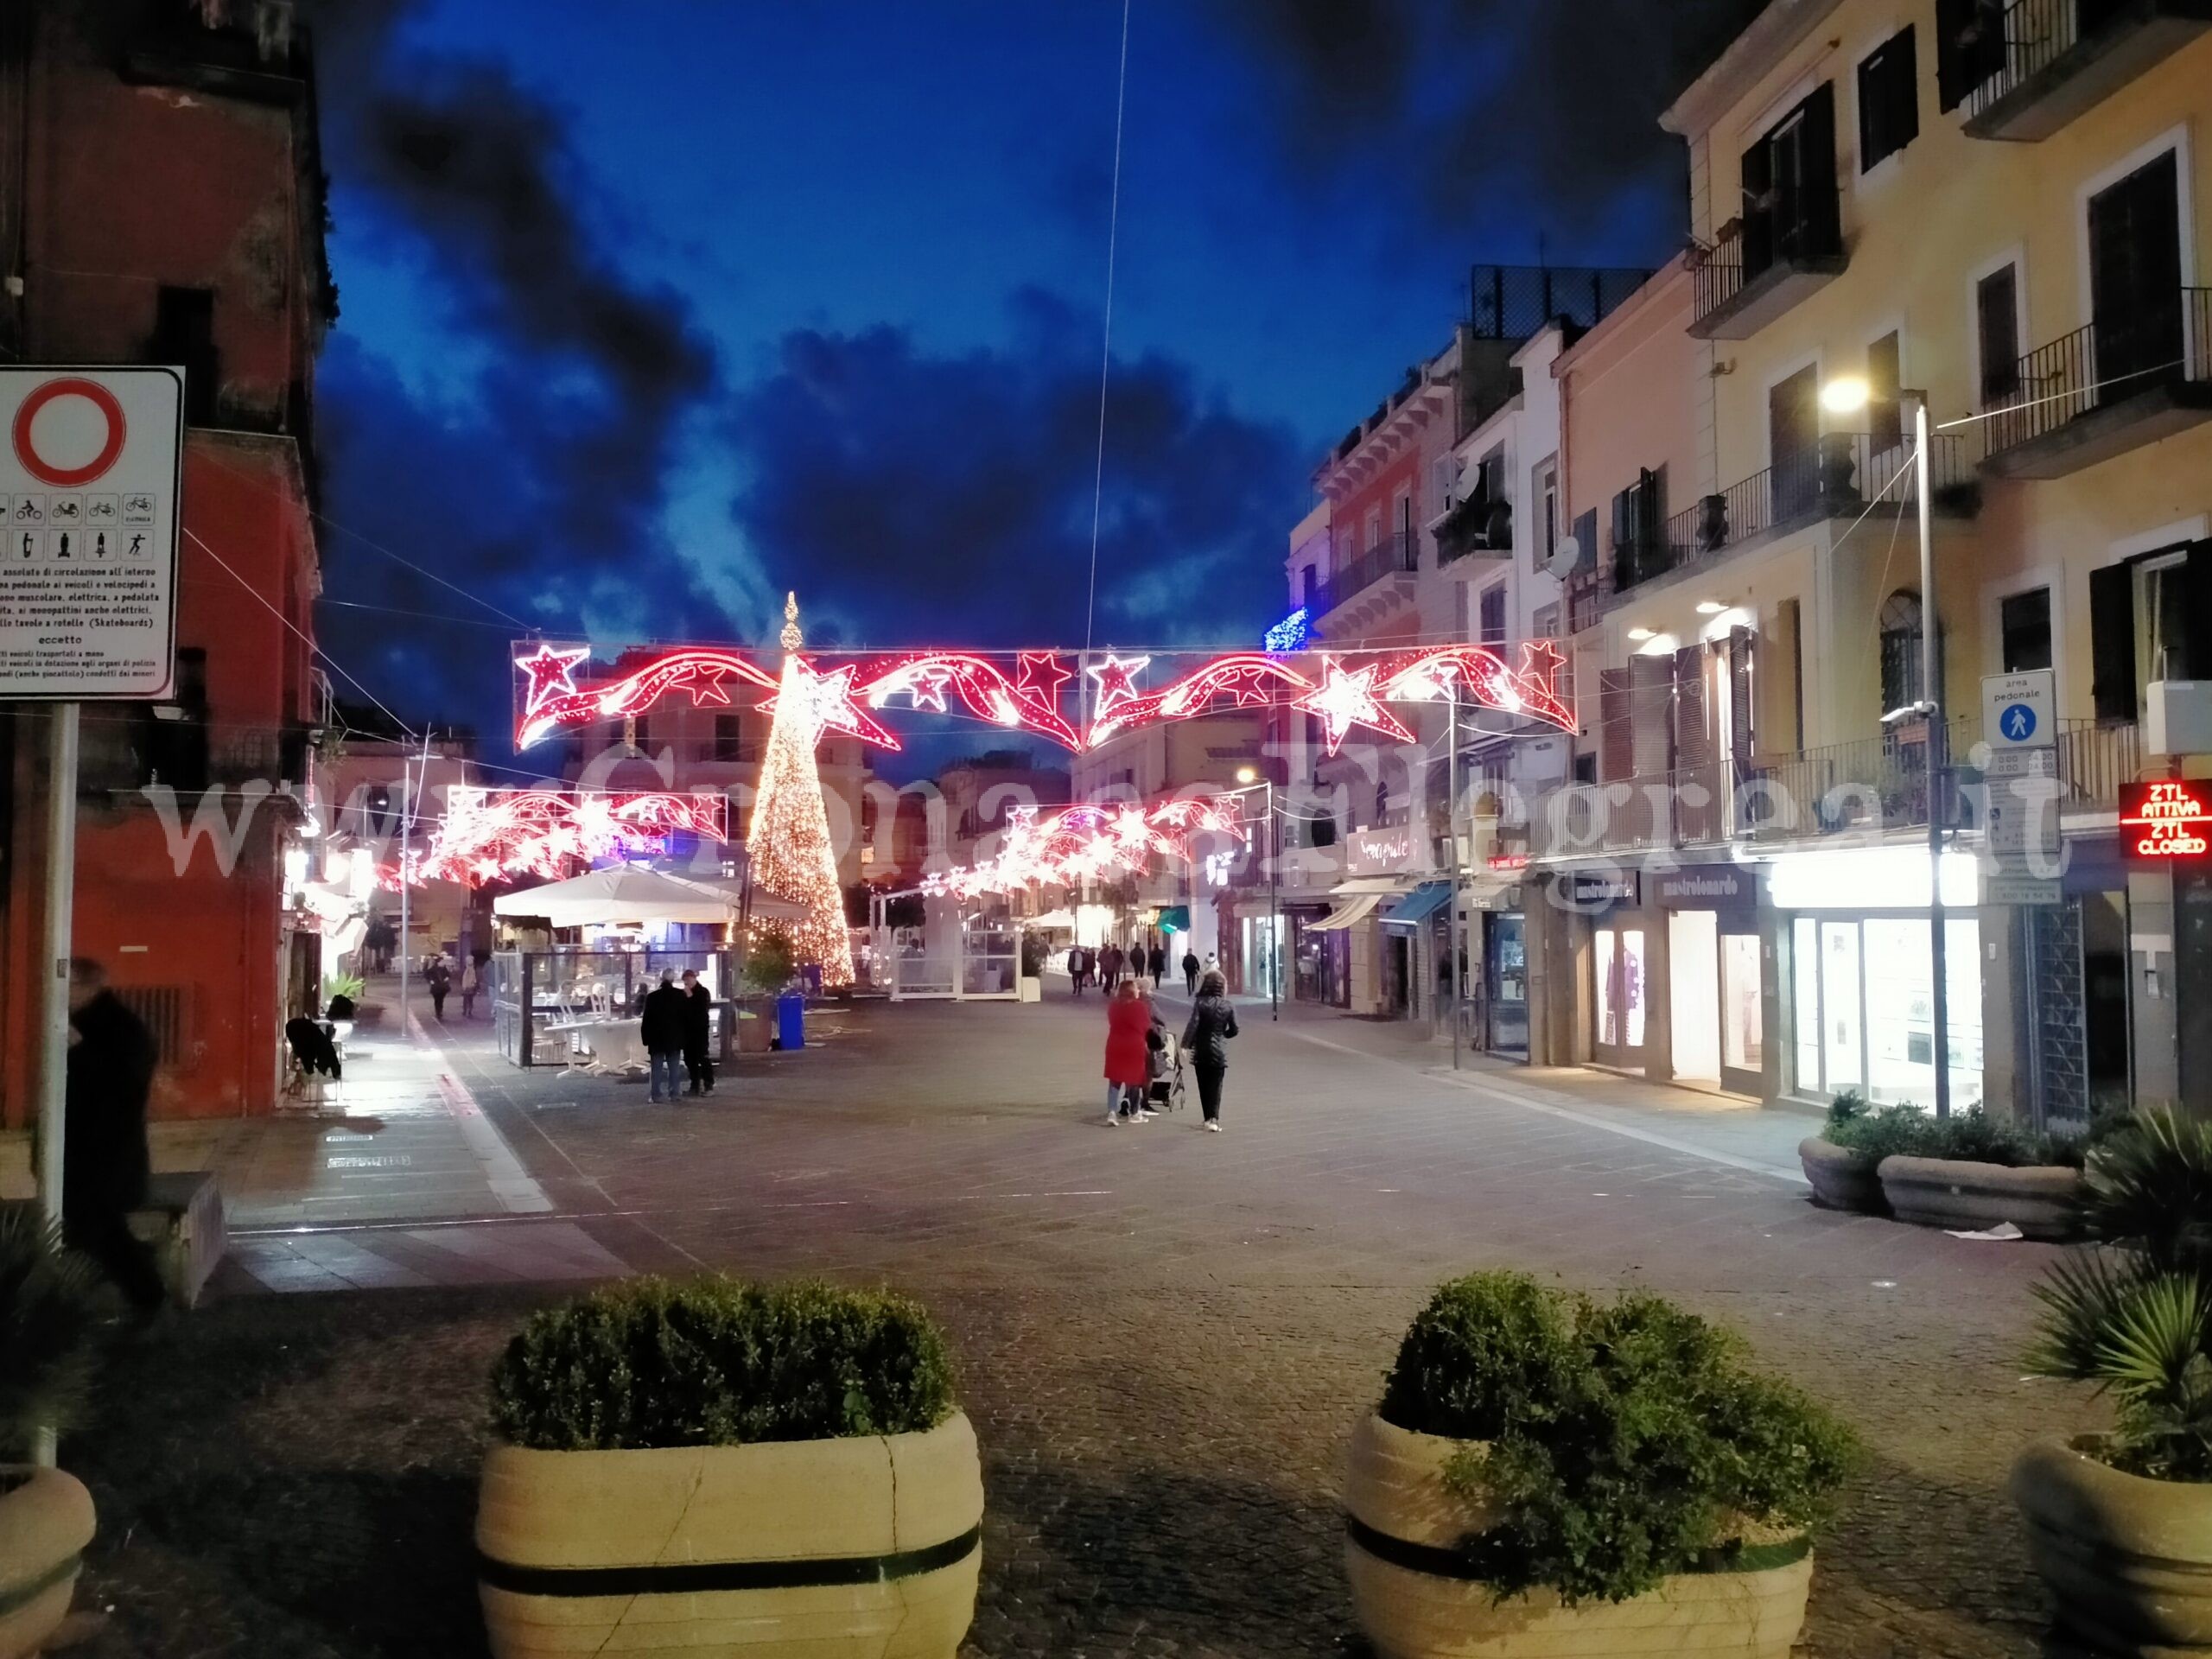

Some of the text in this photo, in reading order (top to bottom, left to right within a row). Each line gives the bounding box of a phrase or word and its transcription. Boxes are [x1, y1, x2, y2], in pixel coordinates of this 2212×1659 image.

[43, 567, 51, 576] di
[54, 567, 106, 576] circolazione
[11, 580, 50, 590] pedonale
[65, 580, 93, 588] veicoli
[104, 580, 148, 590] velocipedi
[121, 593, 159, 603] pedalata
[29, 606, 82, 616] monopattini
[84, 606, 110, 614] anche
[16, 618, 43, 627] tavole
[54, 618, 84, 627] rotelle
[89, 618, 154, 629] (Skateboards)
[38, 635, 82, 645] eccetto
[1994, 690, 2040, 702] pedonale
[2149, 783, 2190, 802] ZTL
[2141, 799, 2202, 818] ATTIVA
[2151, 821, 2190, 839] ZTL
[2137, 837, 2207, 855] CLOSED
